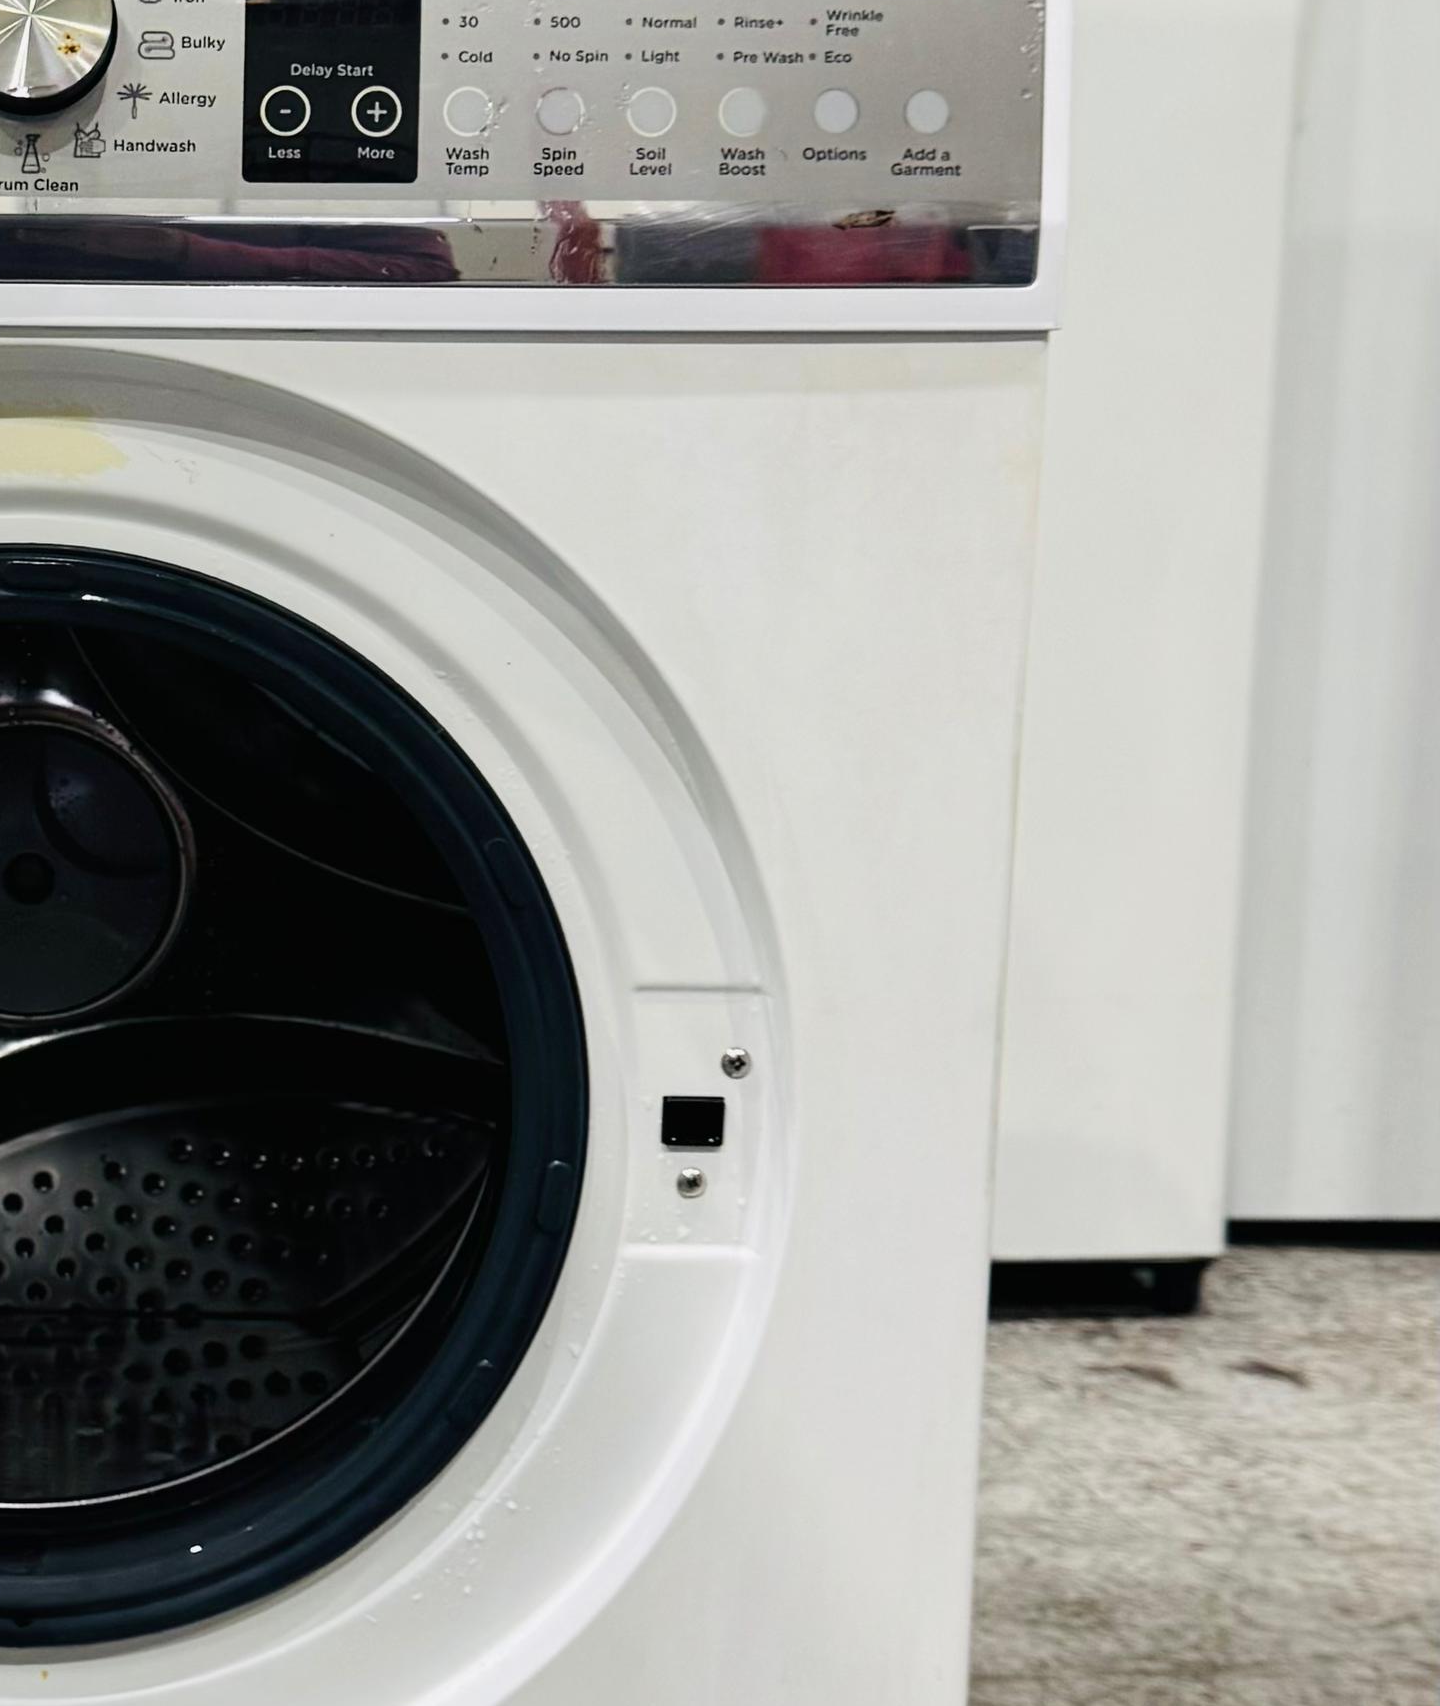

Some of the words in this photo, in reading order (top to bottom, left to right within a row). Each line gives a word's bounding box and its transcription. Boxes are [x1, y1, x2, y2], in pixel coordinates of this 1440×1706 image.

[459, 16, 478, 28] 30
[551, 16, 580, 28] 500
[827, 10, 883, 22] Wrinkle
[642, 17, 696, 28] Normal
[734, 17, 783, 29] Rinse+
[826, 24, 859, 37] Free
[182, 36, 225, 51] Bulky
[459, 51, 492, 63] Cold
[550, 51, 570, 62] No
[576, 50, 608, 63] Spin
[642, 51, 680, 64] Light
[734, 51, 758, 63] Pre
[763, 52, 803, 64] Wash
[825, 51, 852, 63] Eco
[291, 64, 332, 78] Delay
[338, 64, 373, 76] Start
[159, 92, 216, 107] Allergy
[114, 140, 195, 152] Handwash
[269, 147, 300, 158] Less
[358, 147, 394, 159] More
[446, 148, 489, 160] Wash
[542, 148, 576, 162] Spin
[636, 148, 665, 160] Soil
[721, 148, 765, 160] Wash
[803, 147, 867, 162] Options
[903, 148, 936, 161] Add
[941, 151, 950, 161] a
[445, 162, 489, 177] Temp
[534, 163, 584, 177] Speed
[630, 163, 672, 175] Level
[719, 163, 765, 176] Boost
[891, 163, 961, 176] Garment
[34, 179, 78, 191] Clean
